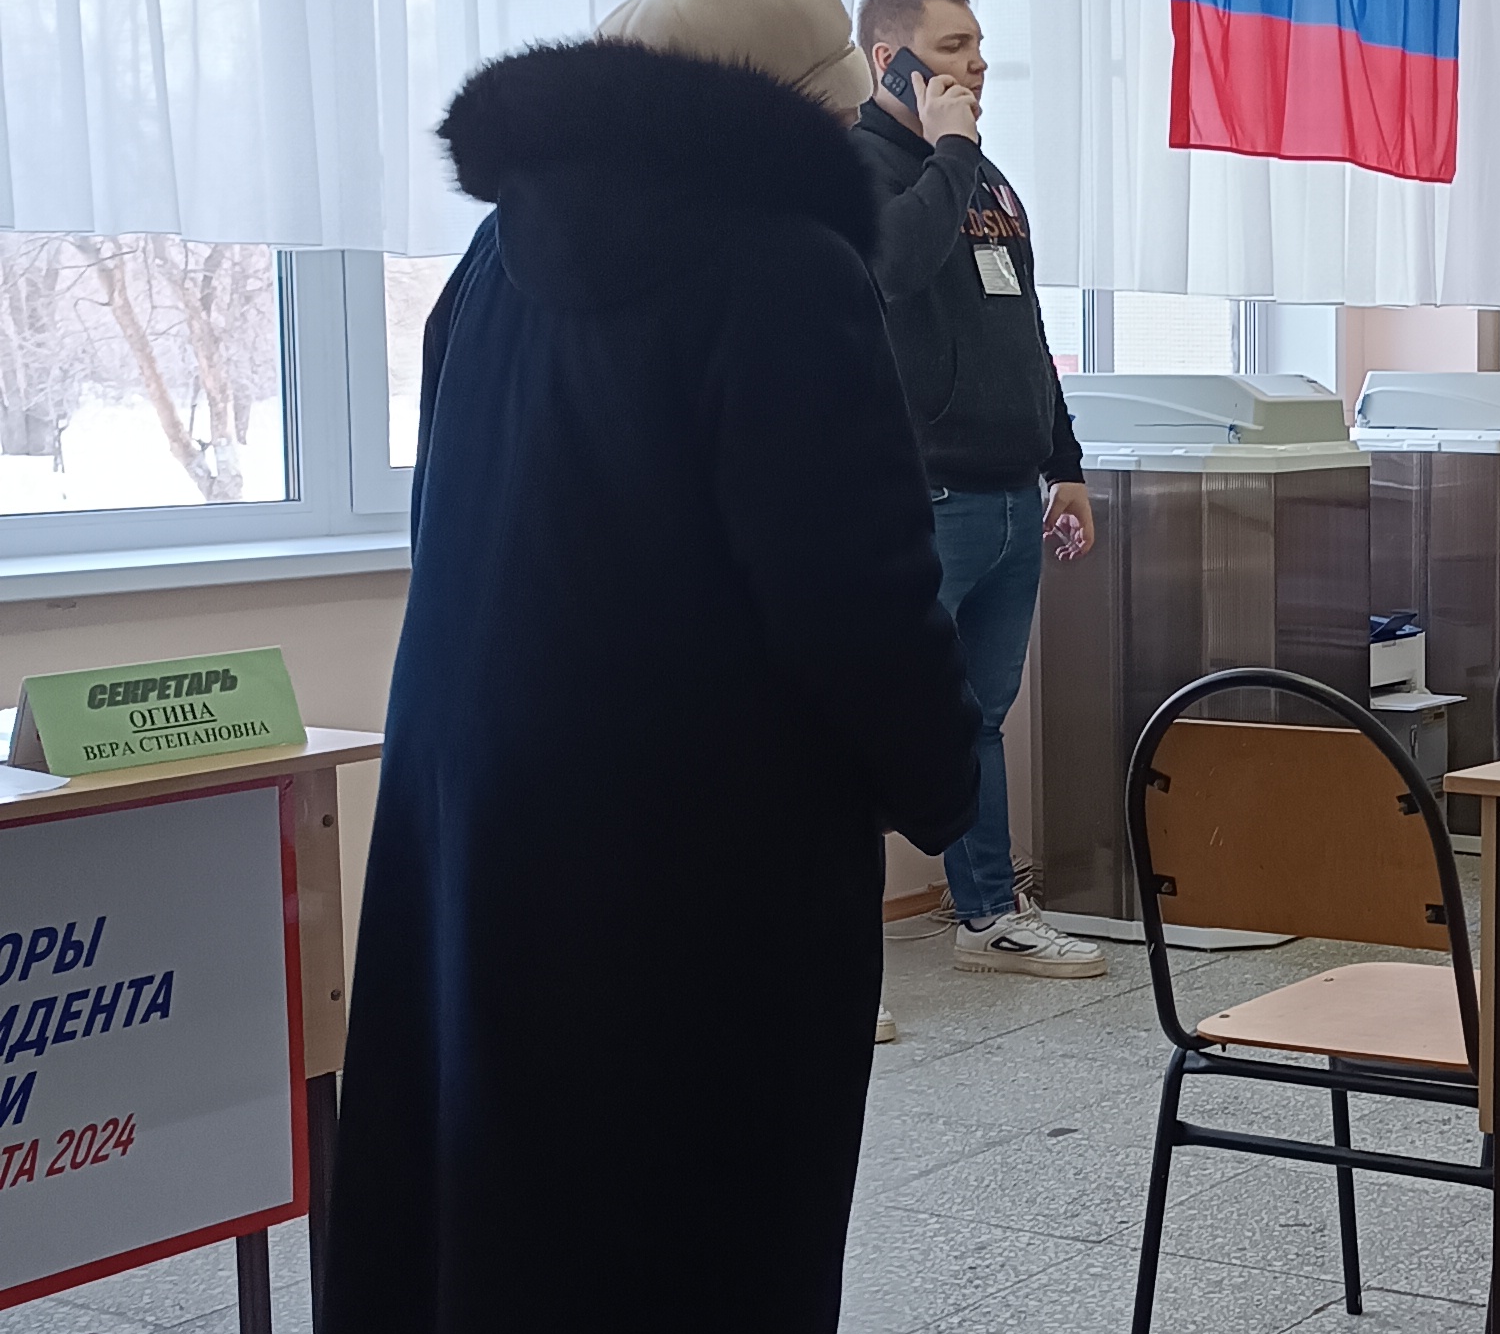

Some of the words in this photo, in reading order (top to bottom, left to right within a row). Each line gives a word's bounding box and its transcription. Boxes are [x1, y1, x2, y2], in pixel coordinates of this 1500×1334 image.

[87, 668, 238, 710] СЕКРЕТАРЬ
[129, 701, 215, 729] ОГИНА
[82, 741, 135, 761] ВЕРА
[139, 721, 270, 753] СТЕПАНОВНА
[45, 1113, 136, 1178] 2024
